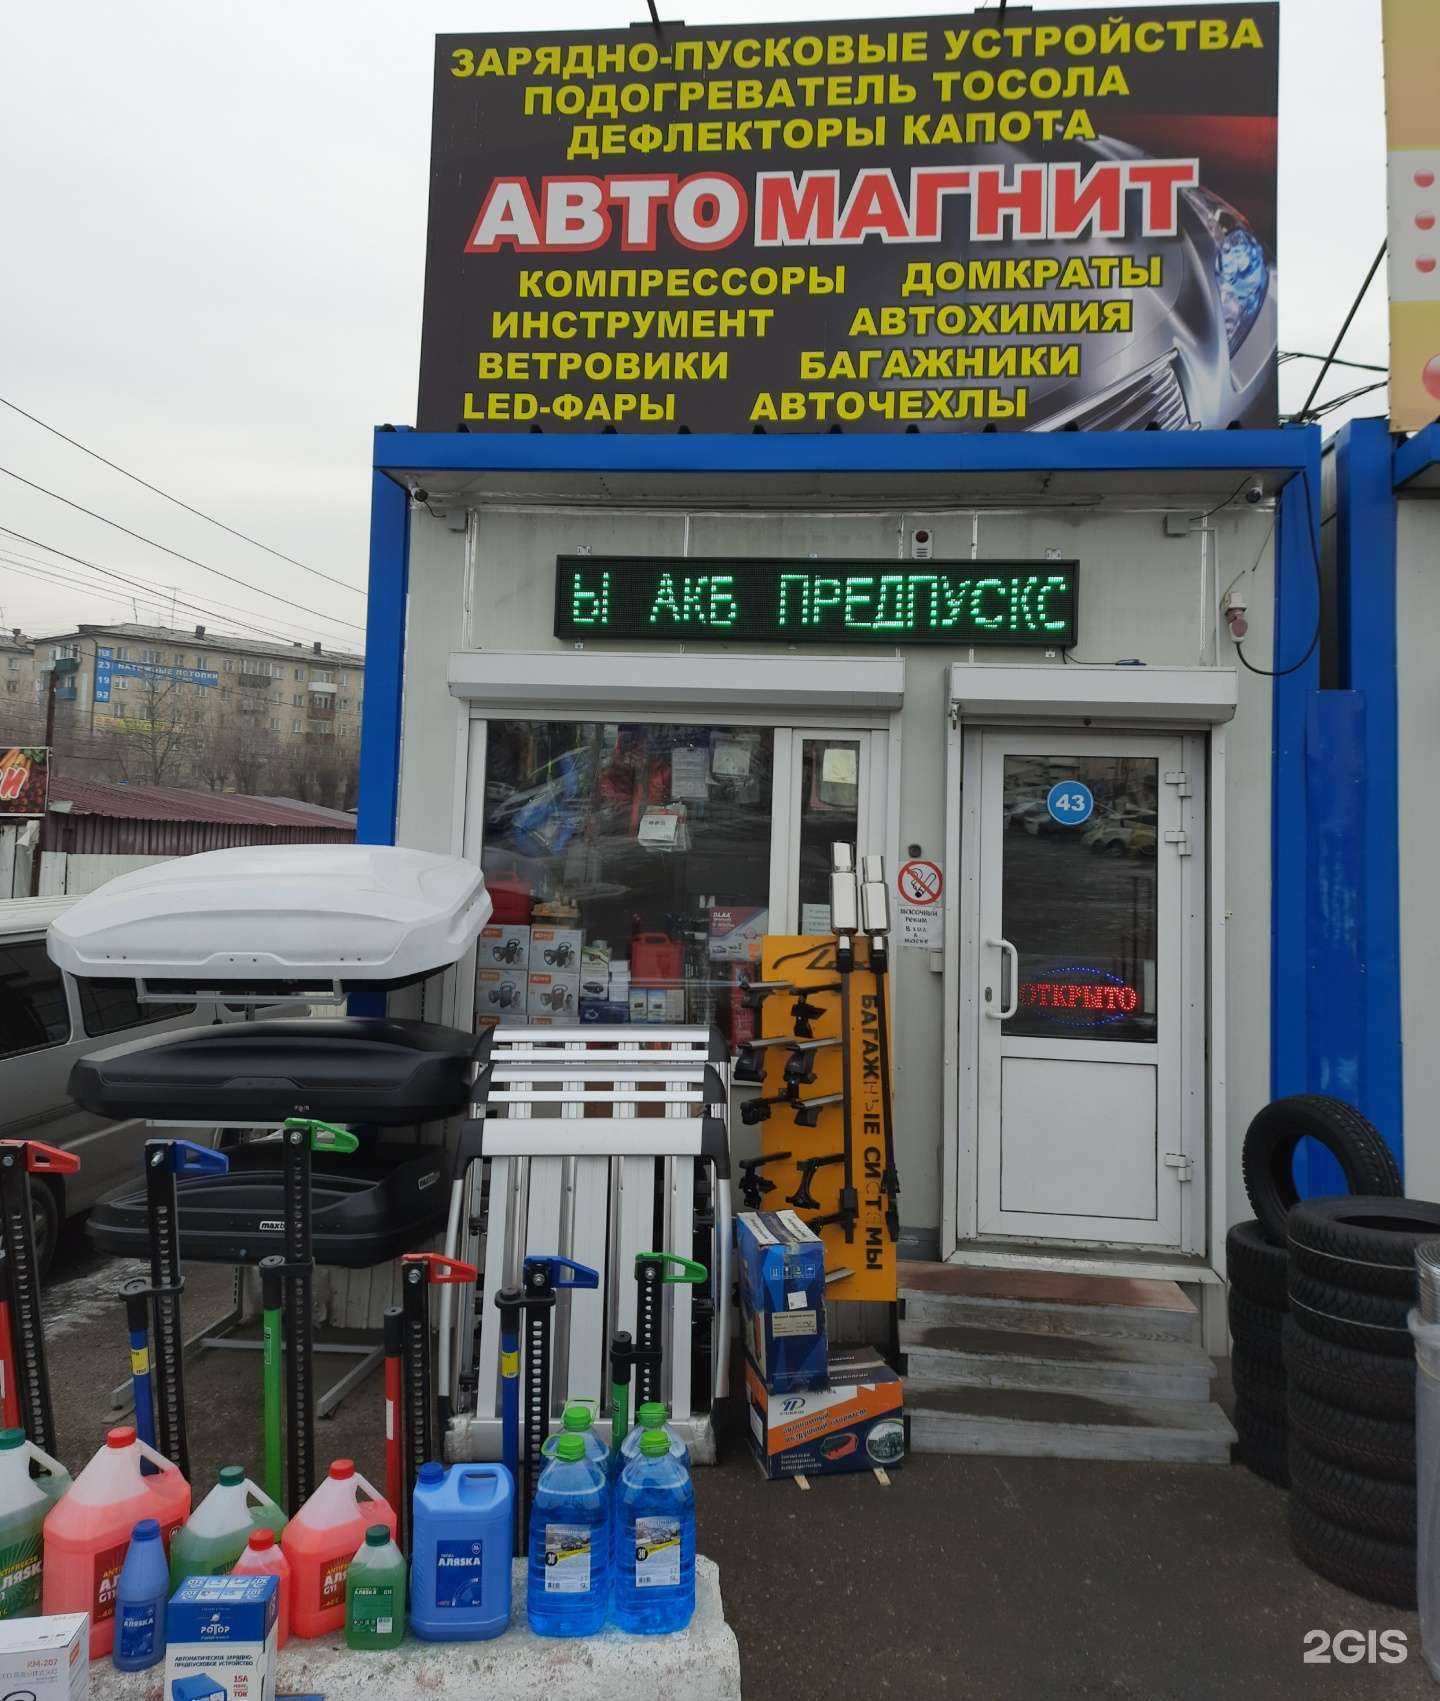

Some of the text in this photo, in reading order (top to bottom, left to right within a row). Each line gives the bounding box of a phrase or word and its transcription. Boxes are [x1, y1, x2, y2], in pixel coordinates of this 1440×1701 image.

[450, 17, 1264, 79] ЗАРЯДНО-ПУСКОВЫЕ УСТРОЙСТВА
[523, 65, 1130, 119] ПОДОГРЕВАТЕЛЬ ТОСОЛА
[566, 109, 1096, 160] ДЕФЛЕКТОРЫ КАПОТА
[464, 158, 1199, 253] АВТОМАГНИТ
[519, 255, 1162, 298] КОМПРЕССОРЫ ДОМКРАТЫ
[491, 300, 1133, 339] ИНСТРУМЕНТ АВТОХИМИЯ
[478, 344, 1081, 380] ВЕТРОВИКИ БАГАЖНИКИ
[463, 387, 1027, 421] LED-ФАРЫ АВТОЧЕХЛЫ
[573, 572, 609, 623] Ы
[650, 573, 736, 625] АКБ
[1055, 793, 1086, 812] 43
[1020, 983, 1137, 1010] ОТКРЫТО
[864, 1146, 883, 1270] СИСТМЫ
